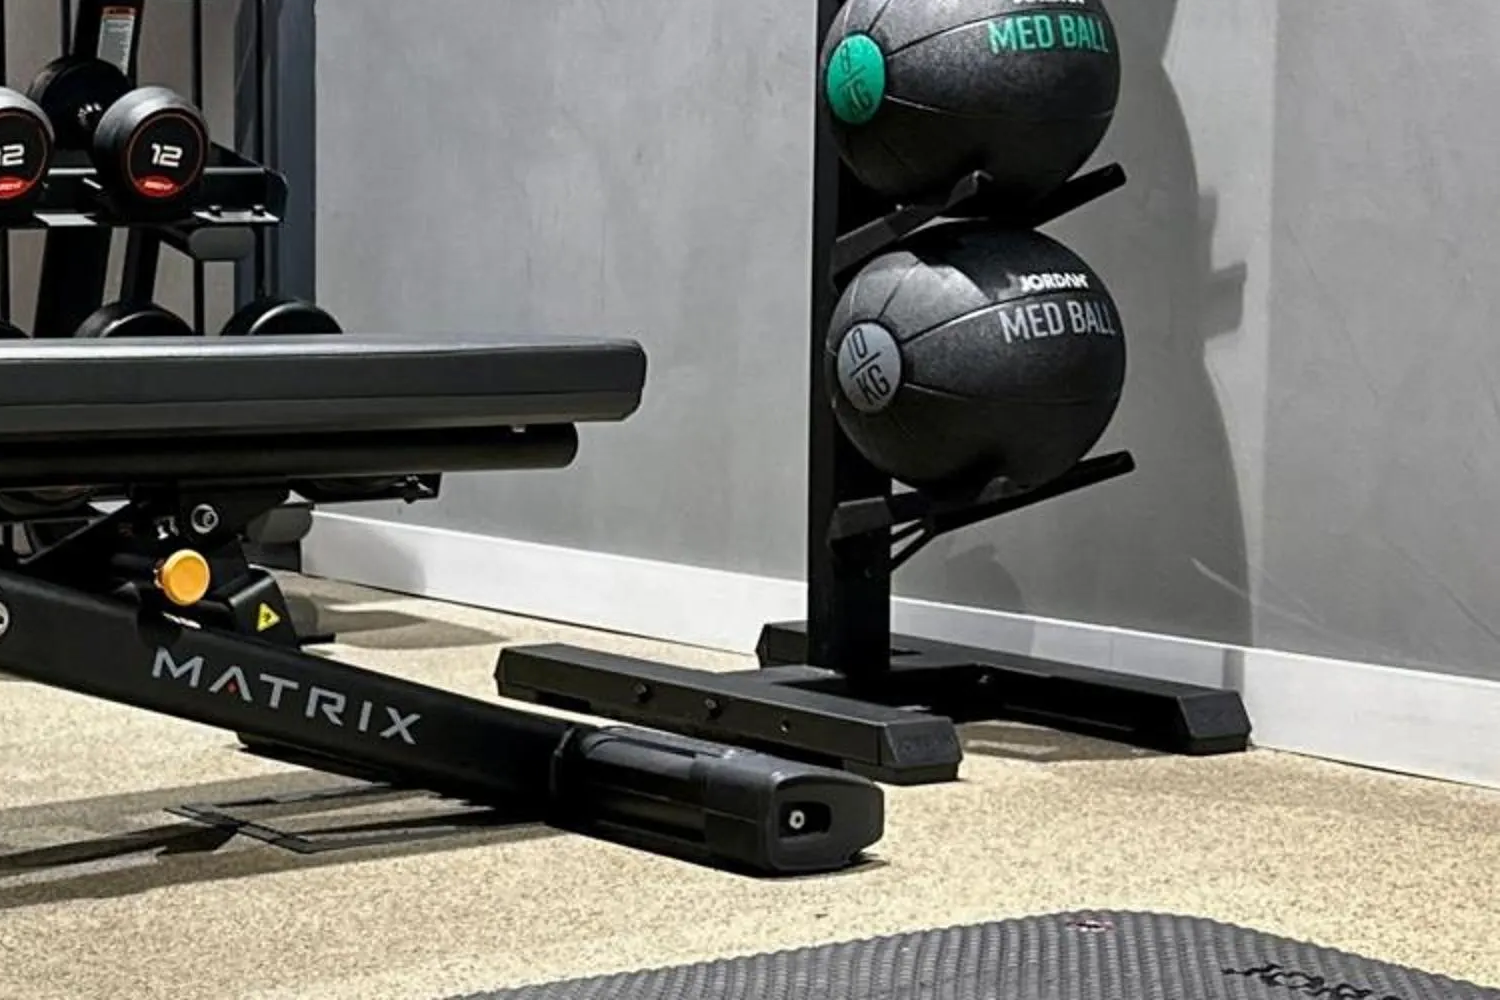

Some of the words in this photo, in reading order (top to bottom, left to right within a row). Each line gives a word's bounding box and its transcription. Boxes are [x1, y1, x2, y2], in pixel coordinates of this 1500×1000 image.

[987, 14, 1055, 54] MED
[1059, 14, 1109, 53] BALL
[151, 142, 183, 168] 12
[1020, 272, 1089, 293] JORDAN
[999, 302, 1065, 344] MED
[1066, 300, 1116, 337] BALL
[856, 364, 891, 405] KG
[151, 646, 422, 745] MATRIX
